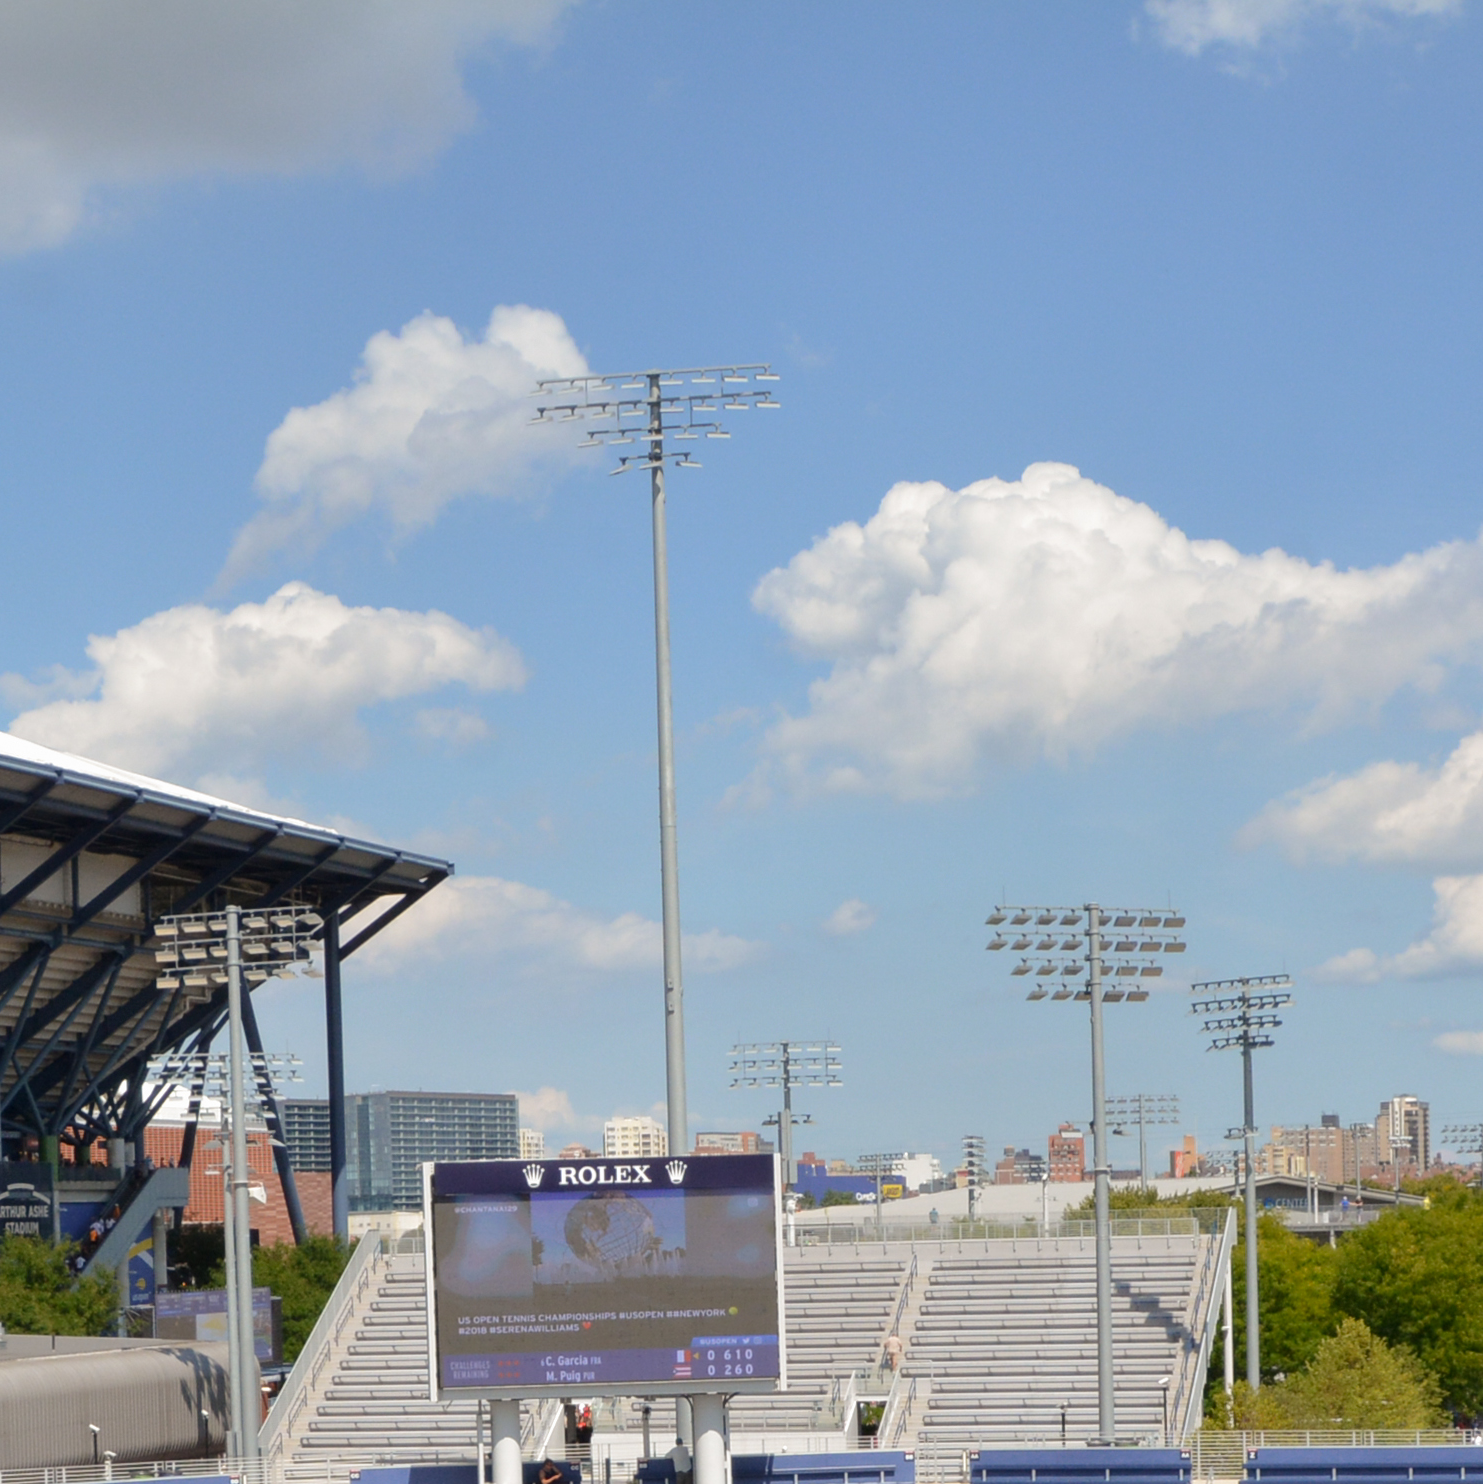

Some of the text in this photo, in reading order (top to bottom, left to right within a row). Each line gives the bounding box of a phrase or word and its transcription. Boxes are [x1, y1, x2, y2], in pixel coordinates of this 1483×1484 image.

[559, 1165, 652, 1186] ROLEX
[28, 1204, 49, 1218] ASHE
[5, 1221, 39, 1235] STADIUM
[458, 1316, 471, 1325] US
[473, 1315, 499, 1324] OPEN
[502, 1314, 536, 1323] TENNIS
[538, 1311, 617, 1322] CHAMPIONSHIPS
[619, 1311, 664, 1320] #USOPEN
[458, 1323, 580, 1335] #2018 #SERENAWILLIAMS
[545, 1356, 556, 1367] C.
[557, 1355, 588, 1366] Garcia
[707, 1350, 715, 1361] 0
[450, 1360, 491, 1371] CHALLENGES
[708, 1365, 716, 1376] 0
[453, 1370, 489, 1380] REMAINING
[546, 1371, 558, 1382] M.
[560, 1370, 581, 1383] Puig
